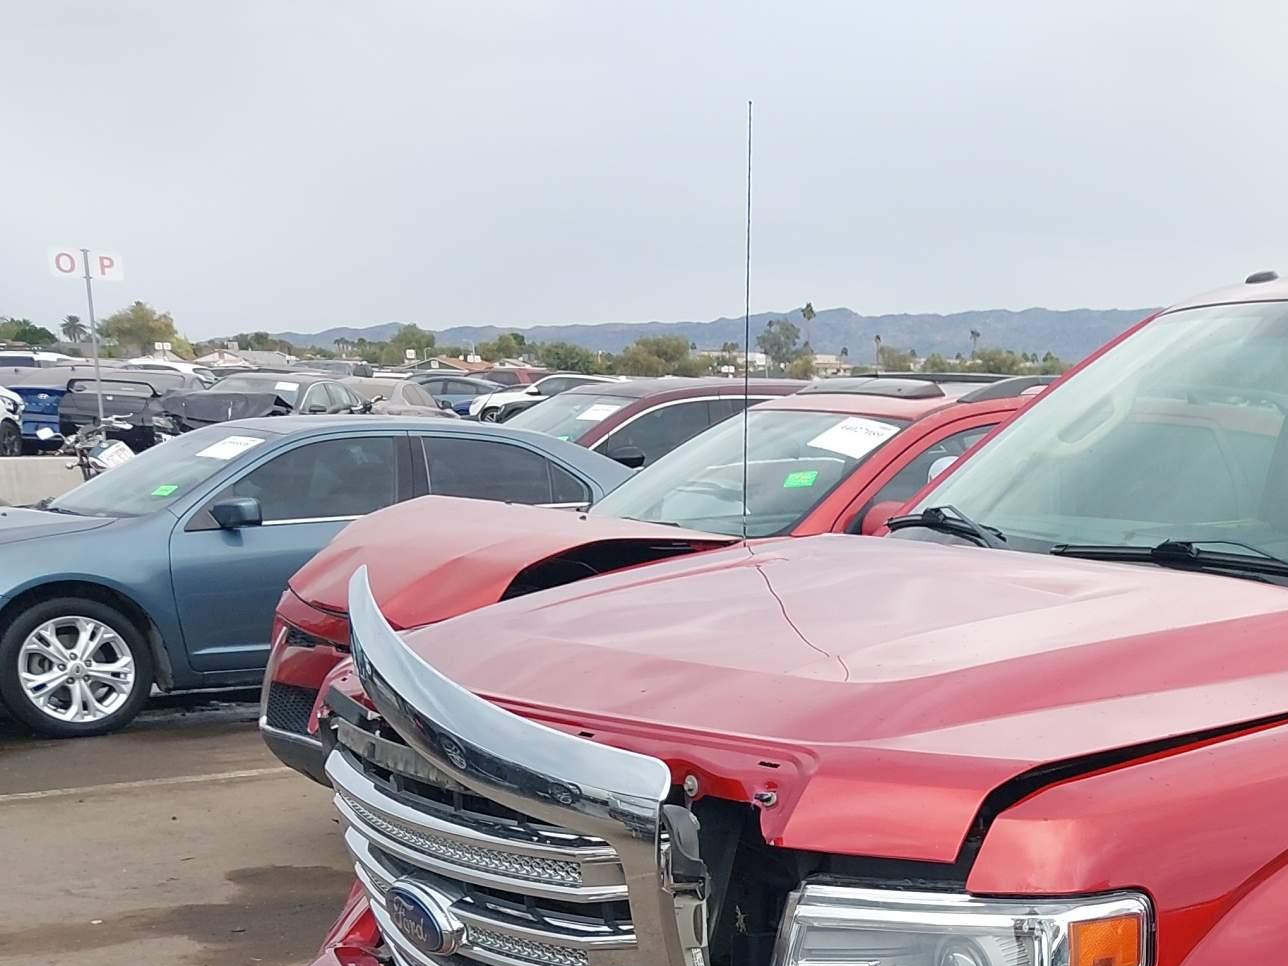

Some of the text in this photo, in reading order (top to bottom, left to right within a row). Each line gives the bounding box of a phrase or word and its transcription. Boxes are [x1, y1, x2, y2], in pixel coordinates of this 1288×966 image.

[55, 252, 76, 273] O
[98, 255, 114, 275] P
[392, 896, 428, 942] Ford
